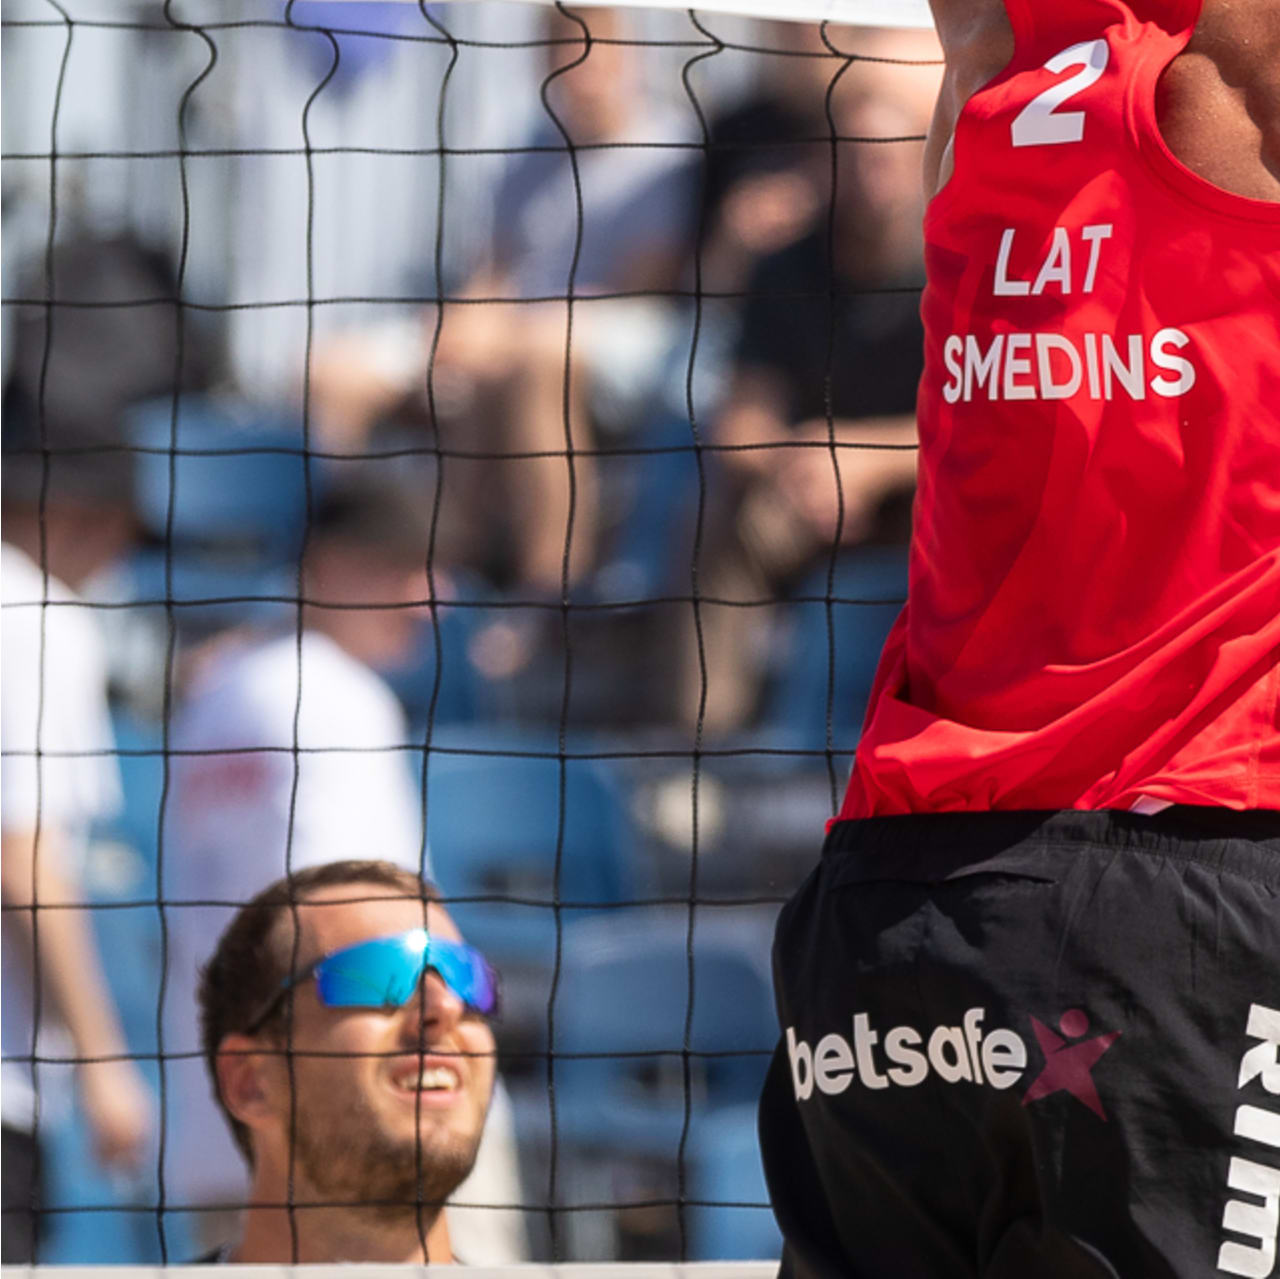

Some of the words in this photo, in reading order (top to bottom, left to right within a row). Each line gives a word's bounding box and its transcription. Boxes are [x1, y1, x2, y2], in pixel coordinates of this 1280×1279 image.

[1011, 38, 1109, 147] 2
[993, 224, 1113, 296] LAT
[942, 327, 1196, 404] SMEDINS
[786, 1007, 1028, 1103] betsafe
